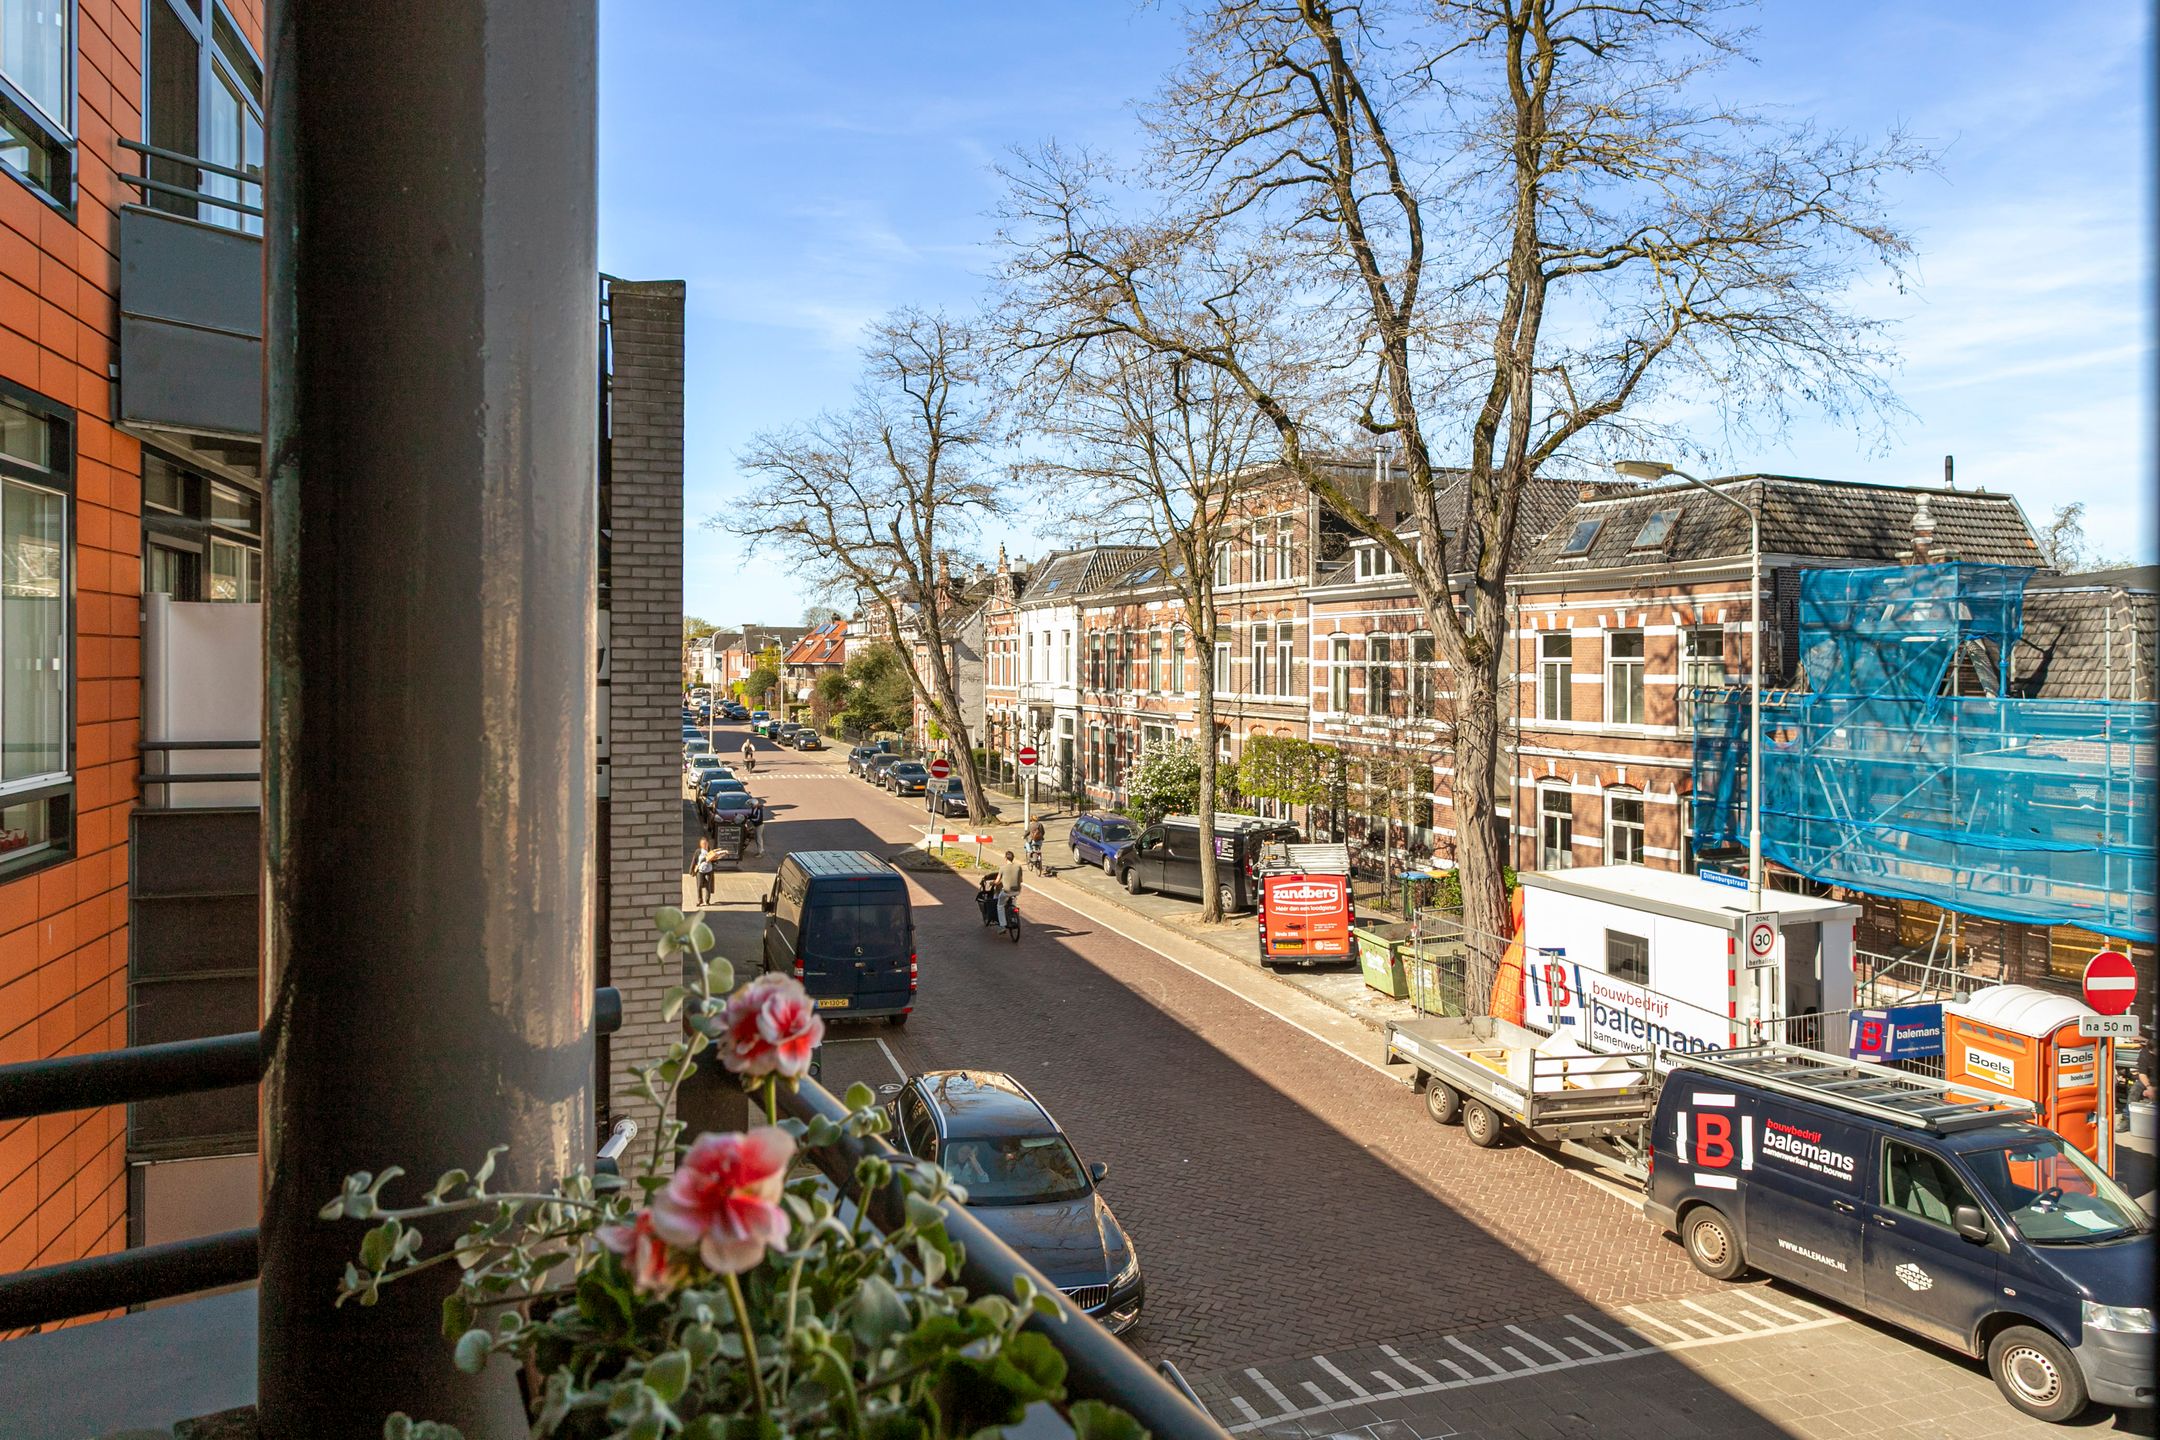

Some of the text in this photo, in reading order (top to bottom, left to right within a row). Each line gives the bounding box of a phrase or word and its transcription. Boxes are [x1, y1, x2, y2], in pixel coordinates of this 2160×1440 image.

[1702, 872, 1747, 888] Dillenburgstraat
[1273, 885, 1338, 901] zandberg
[1754, 933, 1771, 947] 30
[1592, 980, 1669, 1018] bouwbedrijf
[1861, 1021, 1883, 1052] B
[1896, 1027, 1941, 1040] balemans
[2085, 1021, 2133, 1032] na 50 m
[1969, 1052, 2011, 1075] Boels
[2060, 1051, 2094, 1064] Boels
[1696, 1113, 1735, 1169] B
[1766, 1118, 1822, 1144] bouwbedrijf
[1763, 1127, 1854, 1172] balemans
[1762, 1147, 1853, 1182] samenwerken aan bouwen
[1778, 1238, 1848, 1273] WWW.BALEMANS.NL
